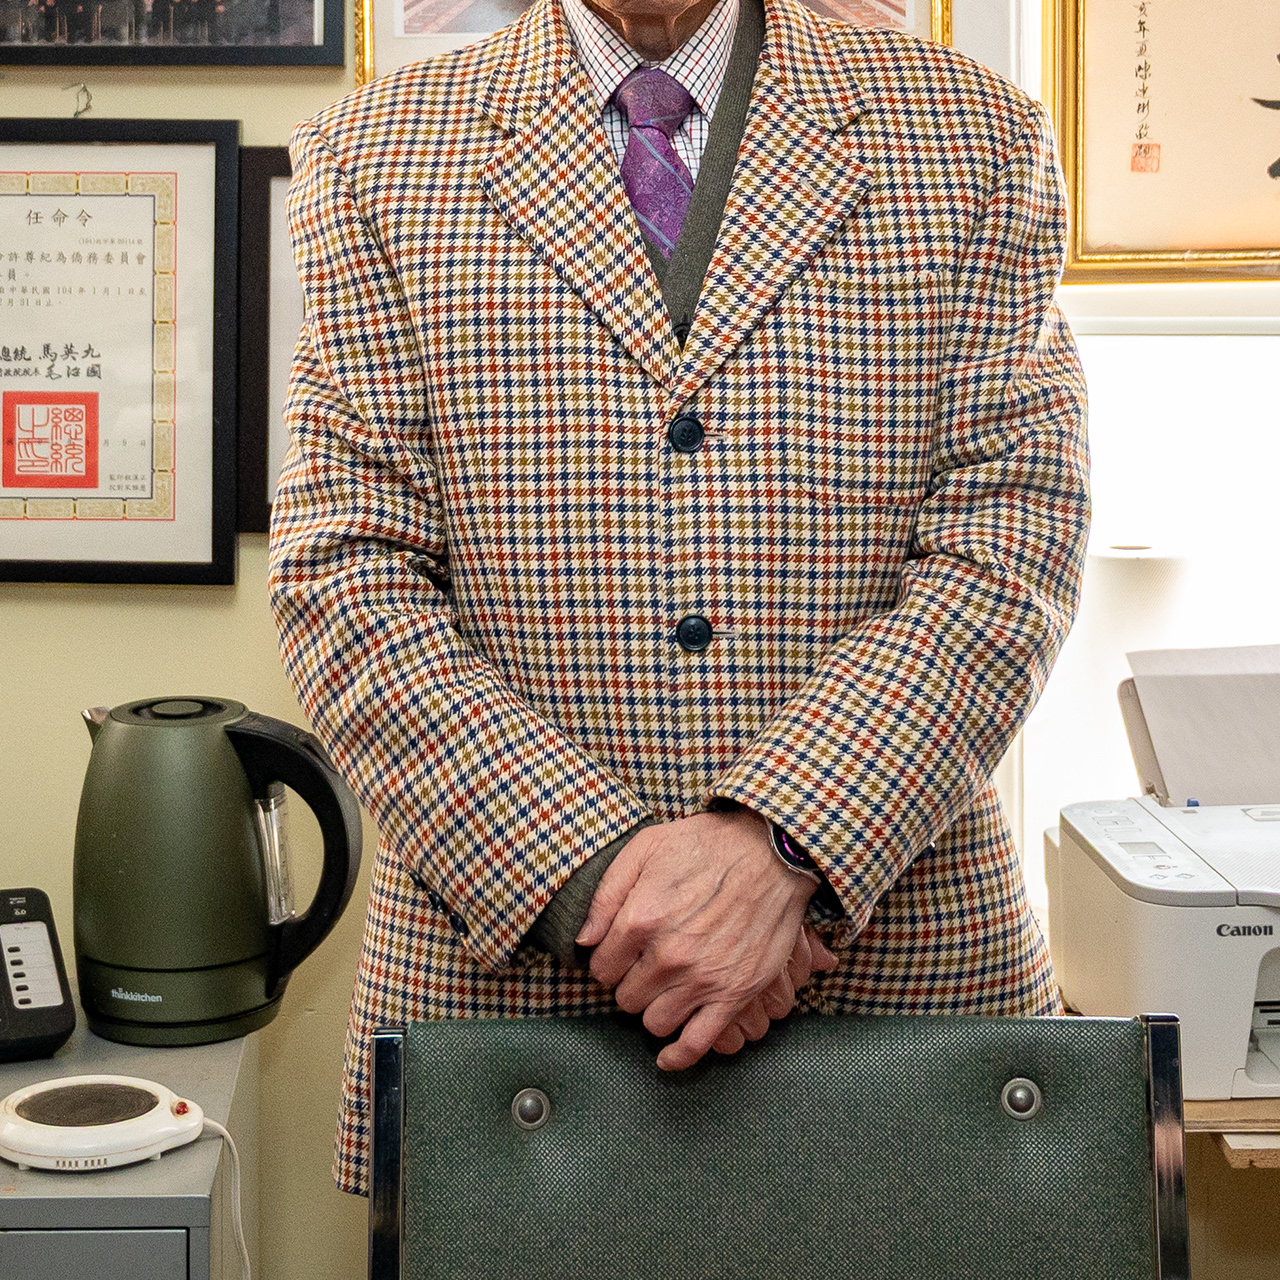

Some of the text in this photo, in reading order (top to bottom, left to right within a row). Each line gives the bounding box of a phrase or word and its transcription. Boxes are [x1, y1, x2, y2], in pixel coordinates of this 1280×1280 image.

[25, 208, 93, 228] 任命令
[38, 342, 101, 363] 馬英九
[1216, 924, 1273, 937] Canon
